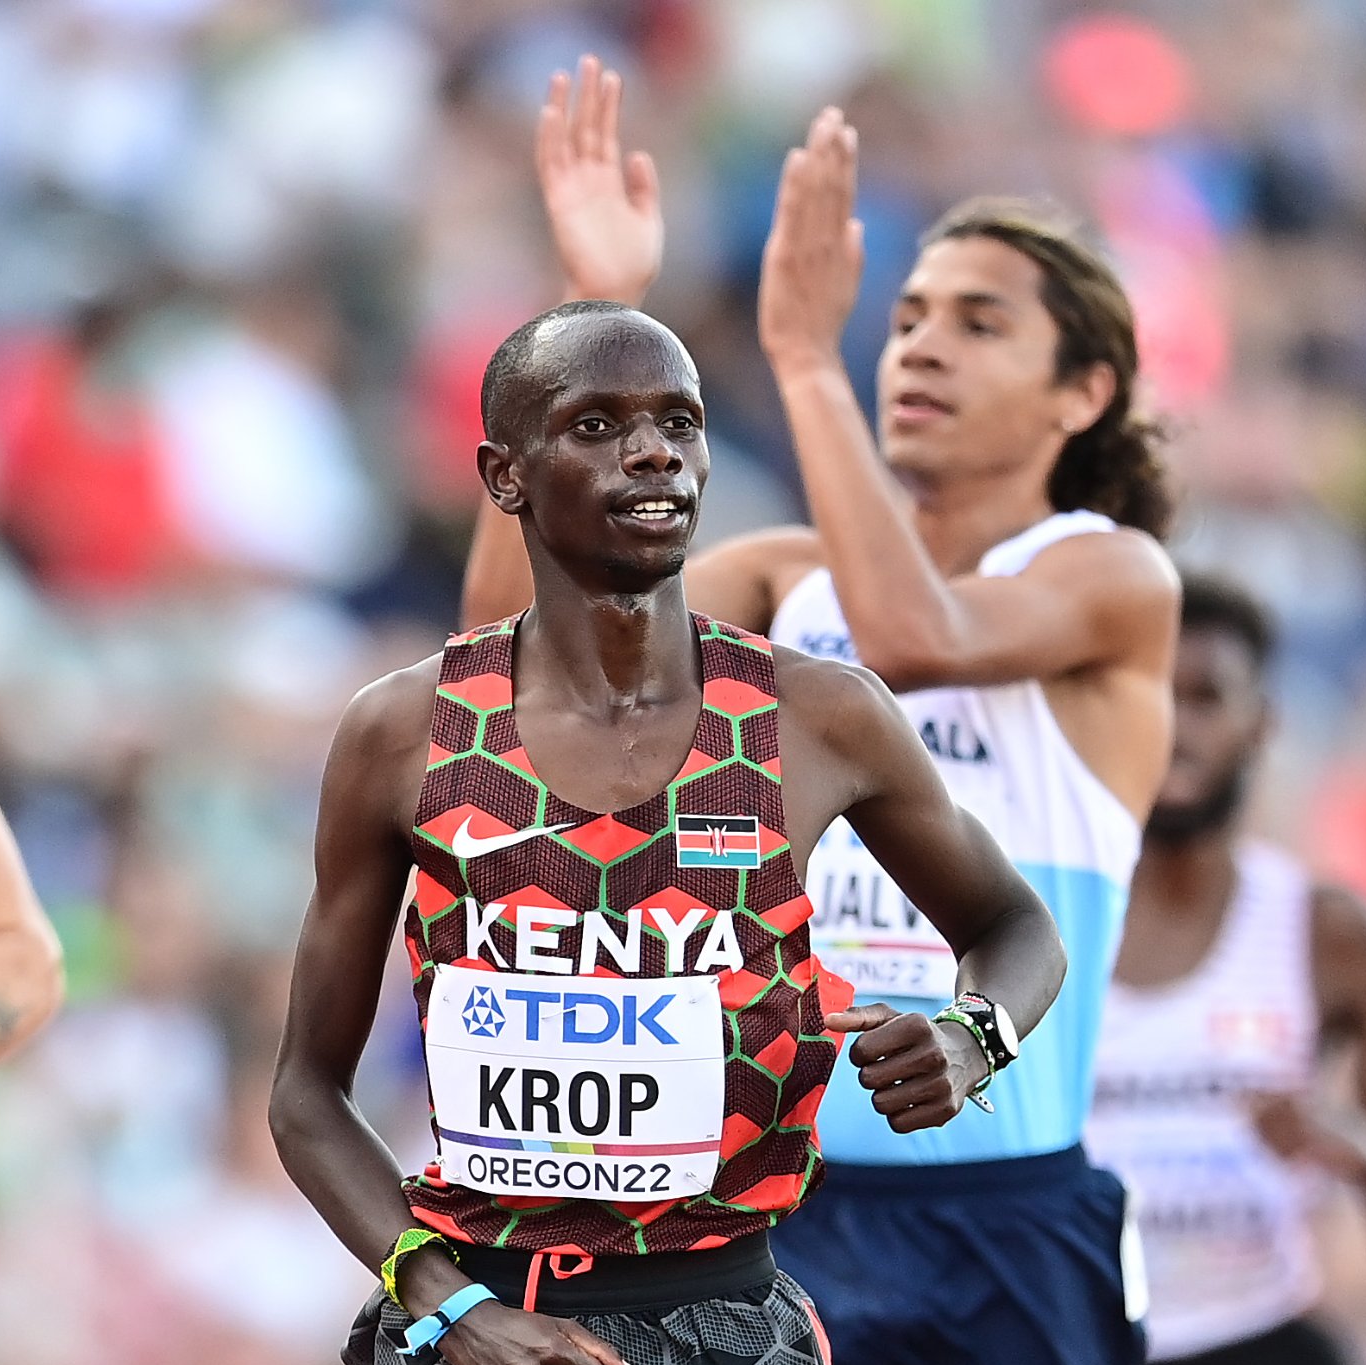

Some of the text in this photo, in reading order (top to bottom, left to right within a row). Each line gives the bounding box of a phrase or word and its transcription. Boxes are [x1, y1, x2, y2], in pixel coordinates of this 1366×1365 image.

[810, 872, 927, 930] JALV
[464, 896, 745, 976] KENYA
[506, 989, 680, 1046] TDK
[478, 1064, 660, 1137] KROP
[467, 1153, 672, 1194] OREGON22
